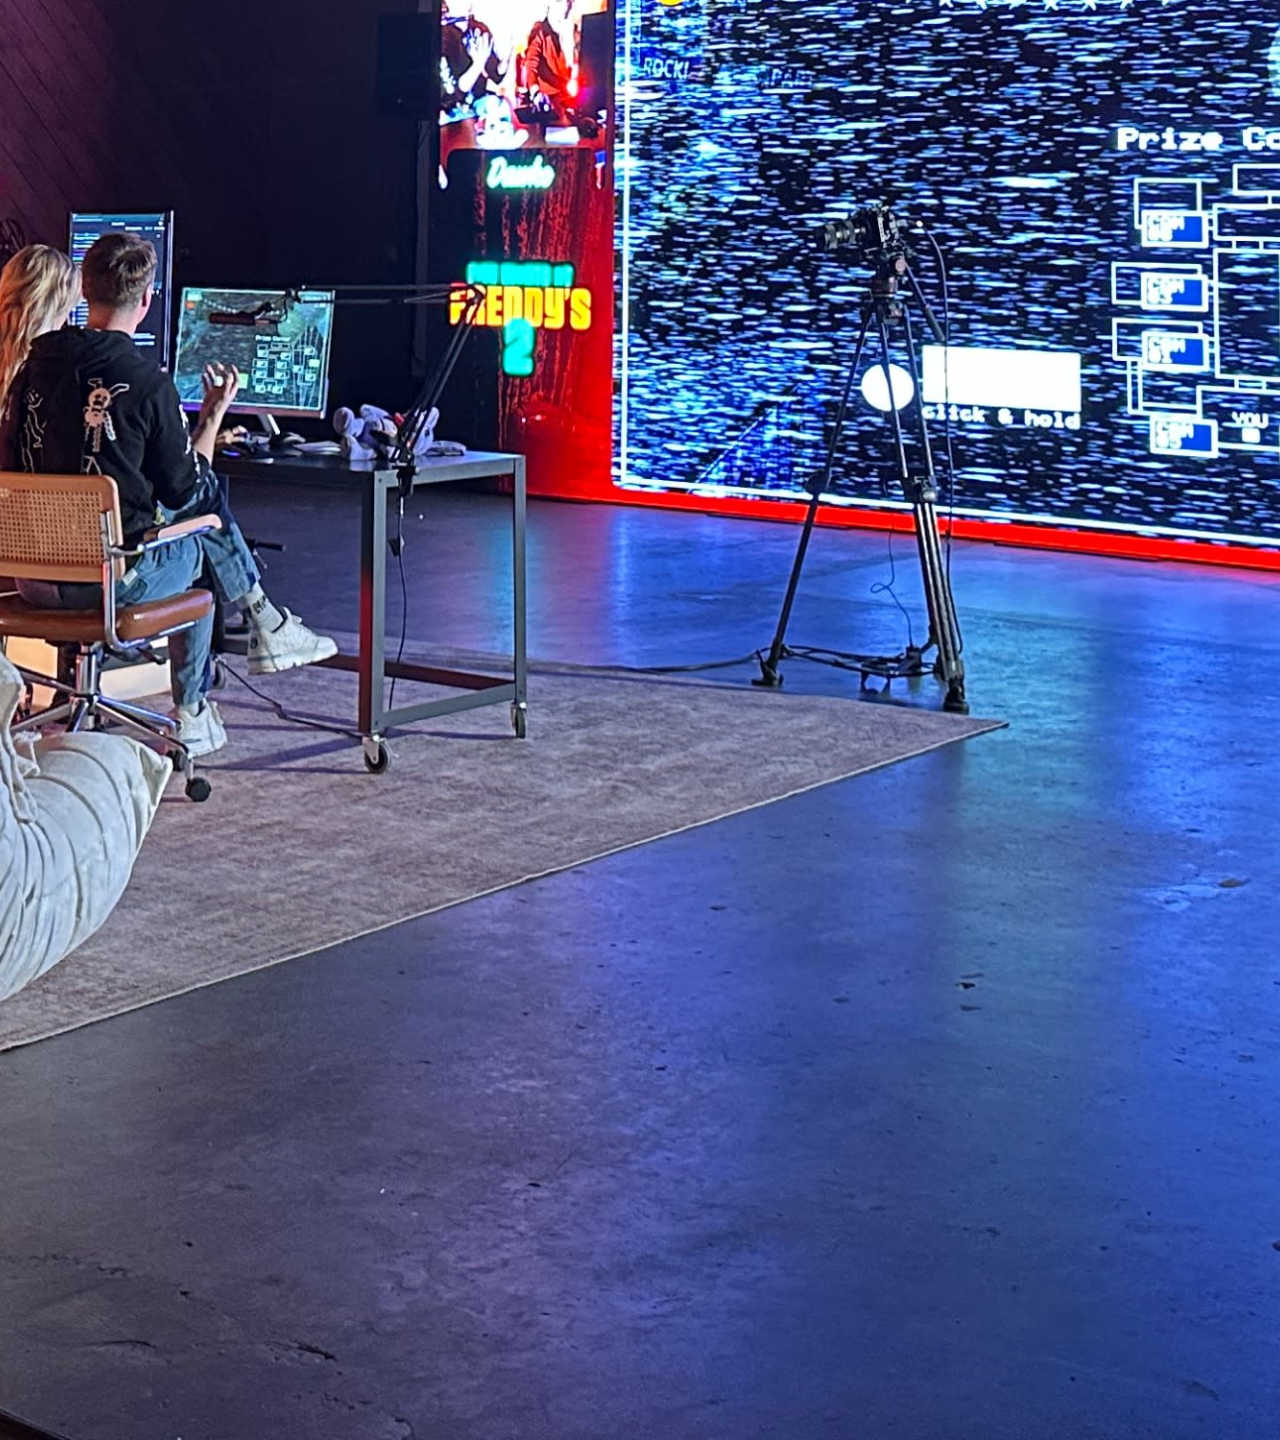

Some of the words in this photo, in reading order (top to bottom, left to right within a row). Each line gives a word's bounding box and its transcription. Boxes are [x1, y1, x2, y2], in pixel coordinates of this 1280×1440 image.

[1117, 126, 1222, 151] Prize
[503, 317, 536, 376] 2
[922, 404, 985, 423] click
[998, 408, 1013, 424] &
[1025, 410, 1080, 430] hold
[1232, 412, 1269, 428] YOU
